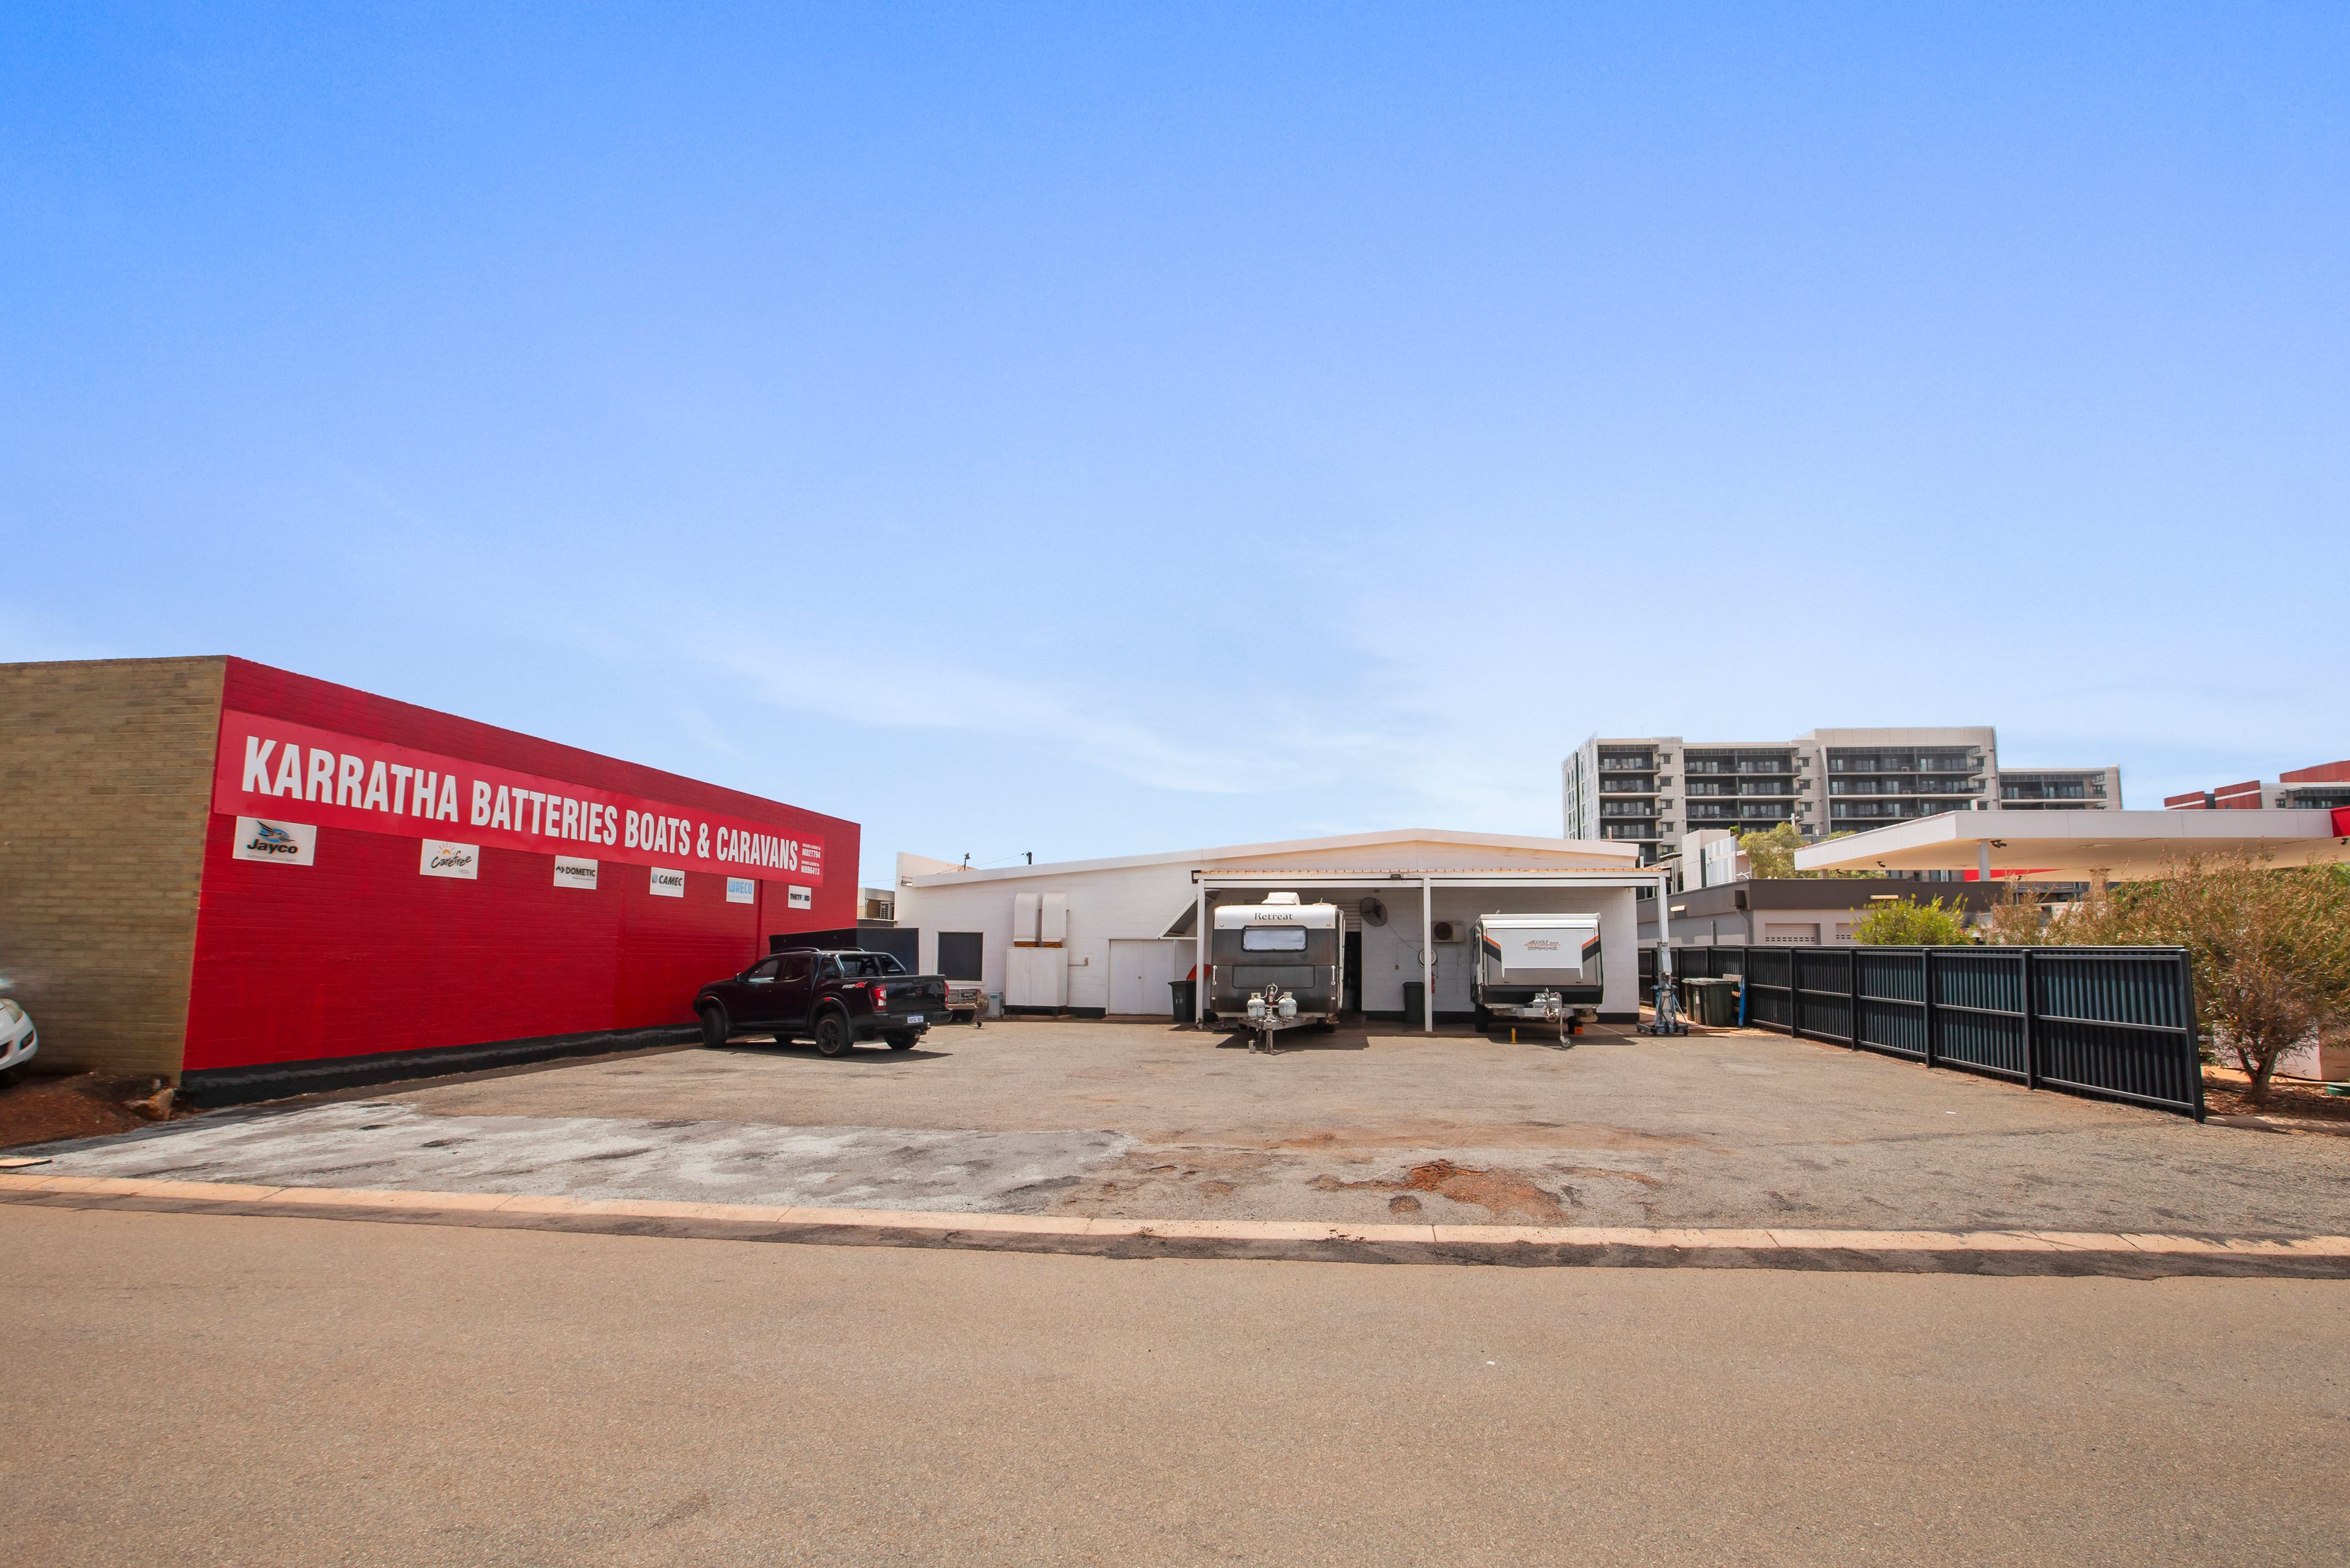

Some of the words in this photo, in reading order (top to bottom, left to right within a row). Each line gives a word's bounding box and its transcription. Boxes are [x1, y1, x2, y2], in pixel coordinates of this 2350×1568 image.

[242, 736, 458, 822] KARRATHA
[471, 780, 617, 845] BATTERIES
[624, 810, 691, 856] BOATS
[696, 823, 710, 858] &
[717, 826, 798, 872] CARAVANS
[246, 838, 299, 854] Jayco
[431, 851, 472, 868] Carefree
[565, 867, 596, 877] DOMETIC
[658, 875, 683, 887] CAMEC
[728, 881, 753, 894] WAECO
